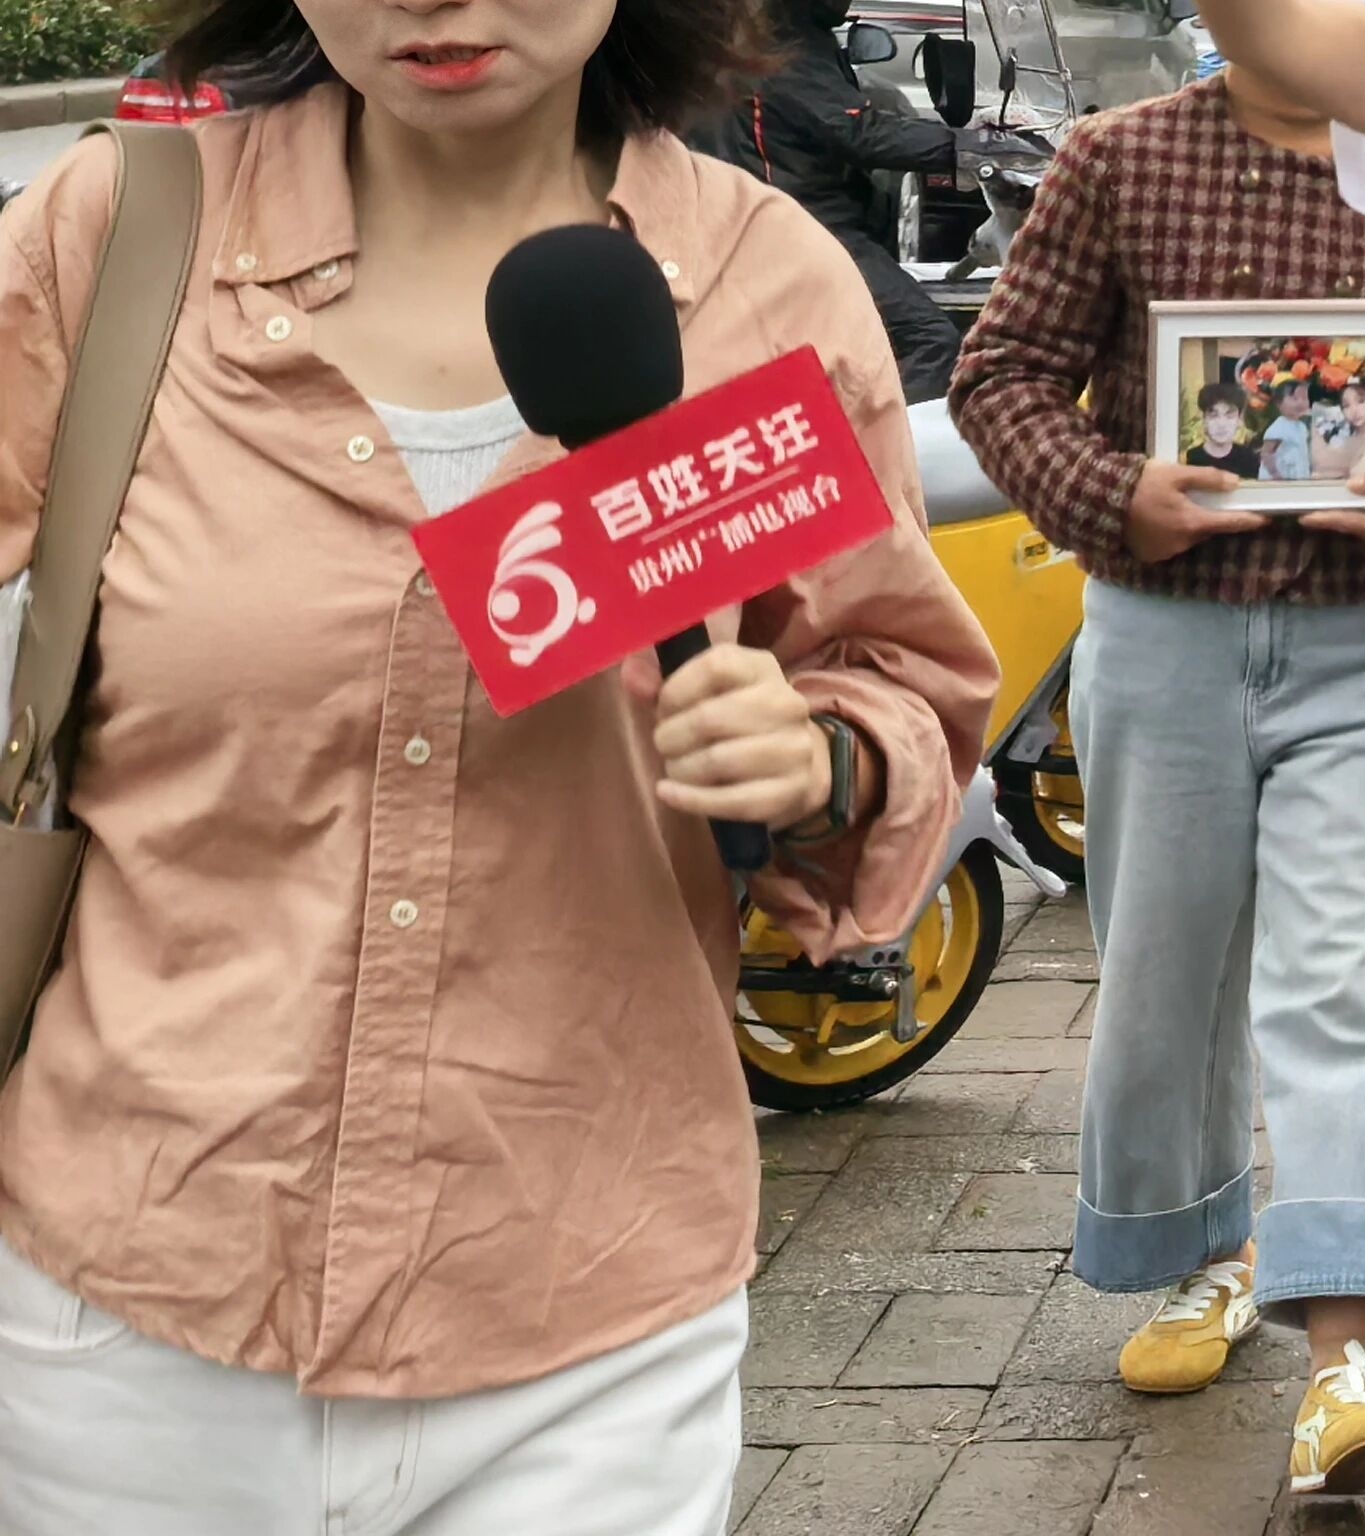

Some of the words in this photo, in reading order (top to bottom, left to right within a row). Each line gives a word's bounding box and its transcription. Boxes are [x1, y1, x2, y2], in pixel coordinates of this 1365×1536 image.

[590, 402, 819, 542] 百姓关注
[628, 473, 842, 593] 贵州广播电视台
